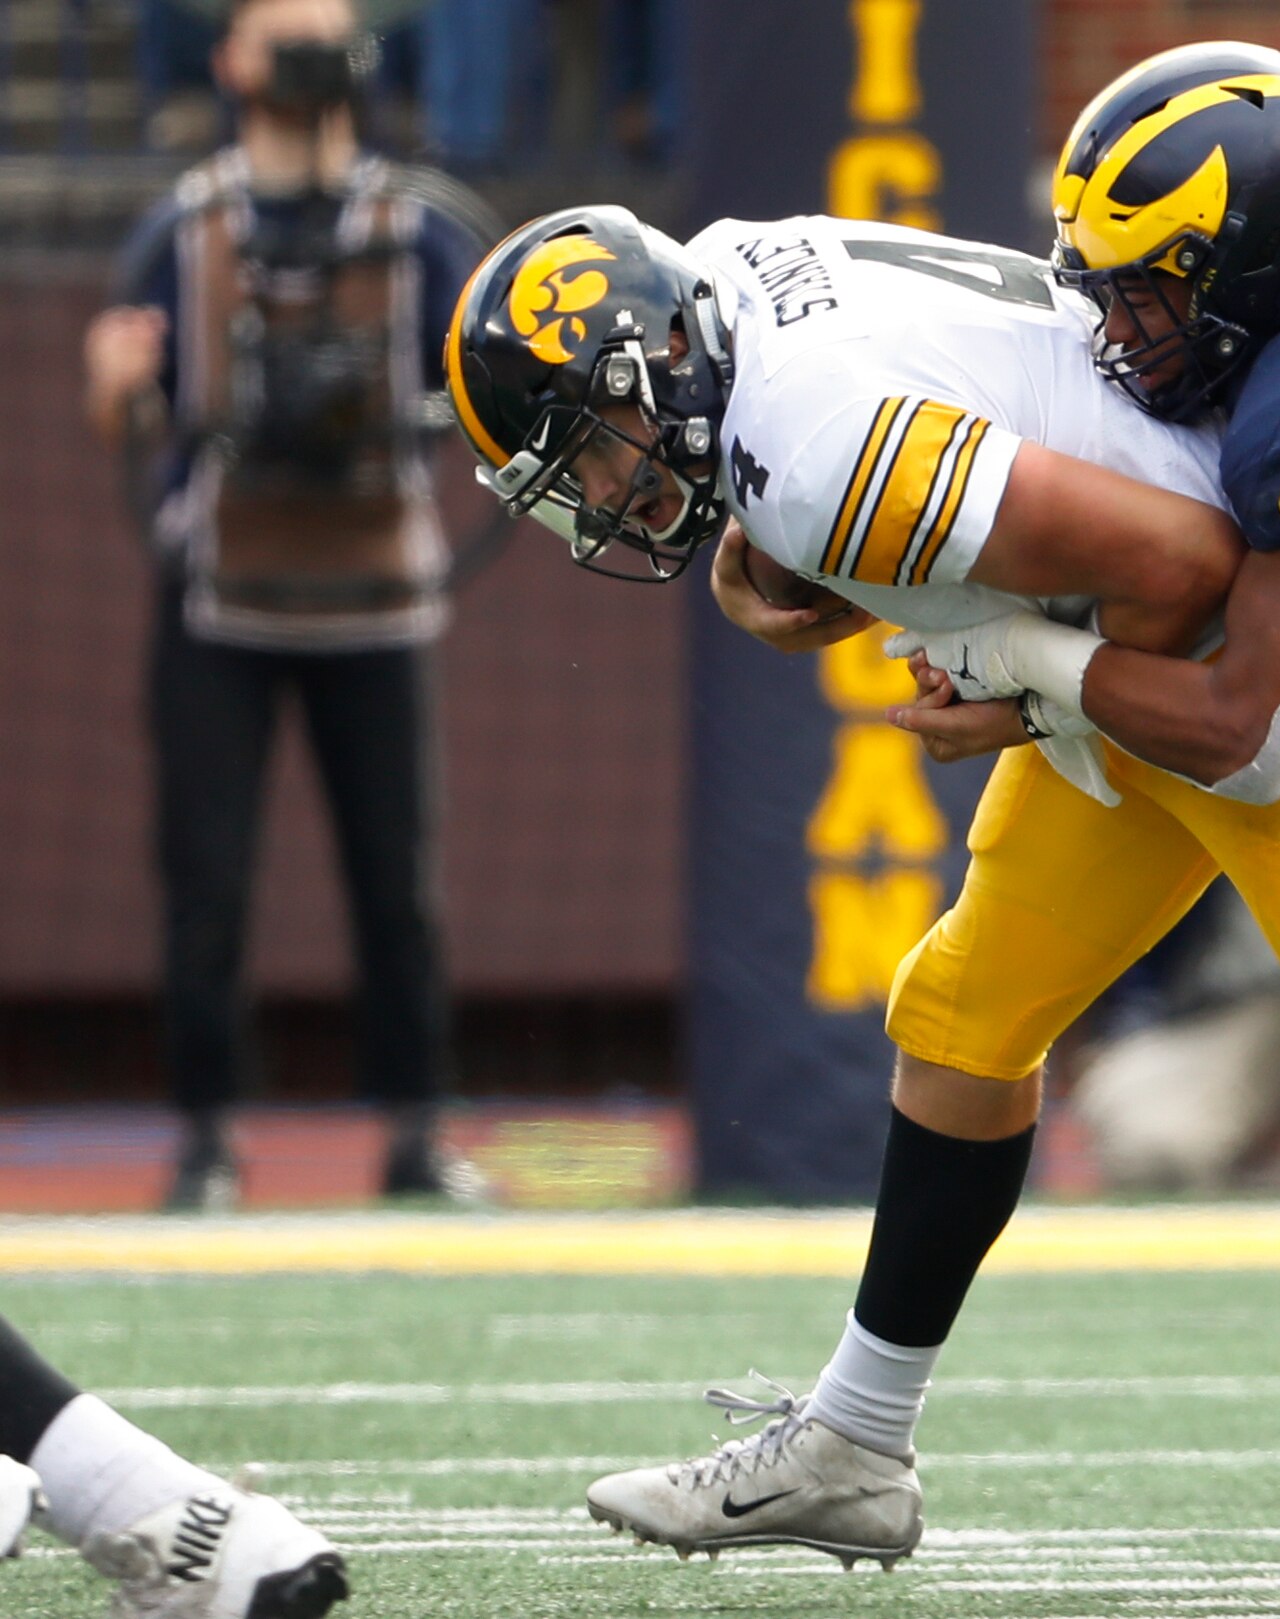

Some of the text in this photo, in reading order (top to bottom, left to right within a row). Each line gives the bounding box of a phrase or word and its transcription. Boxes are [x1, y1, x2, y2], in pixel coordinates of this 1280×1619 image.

[735, 238, 838, 328] STANLEY
[841, 239, 1056, 312] 4
[730, 434, 770, 512] 4
[166, 1497, 233, 1581] NIKE
